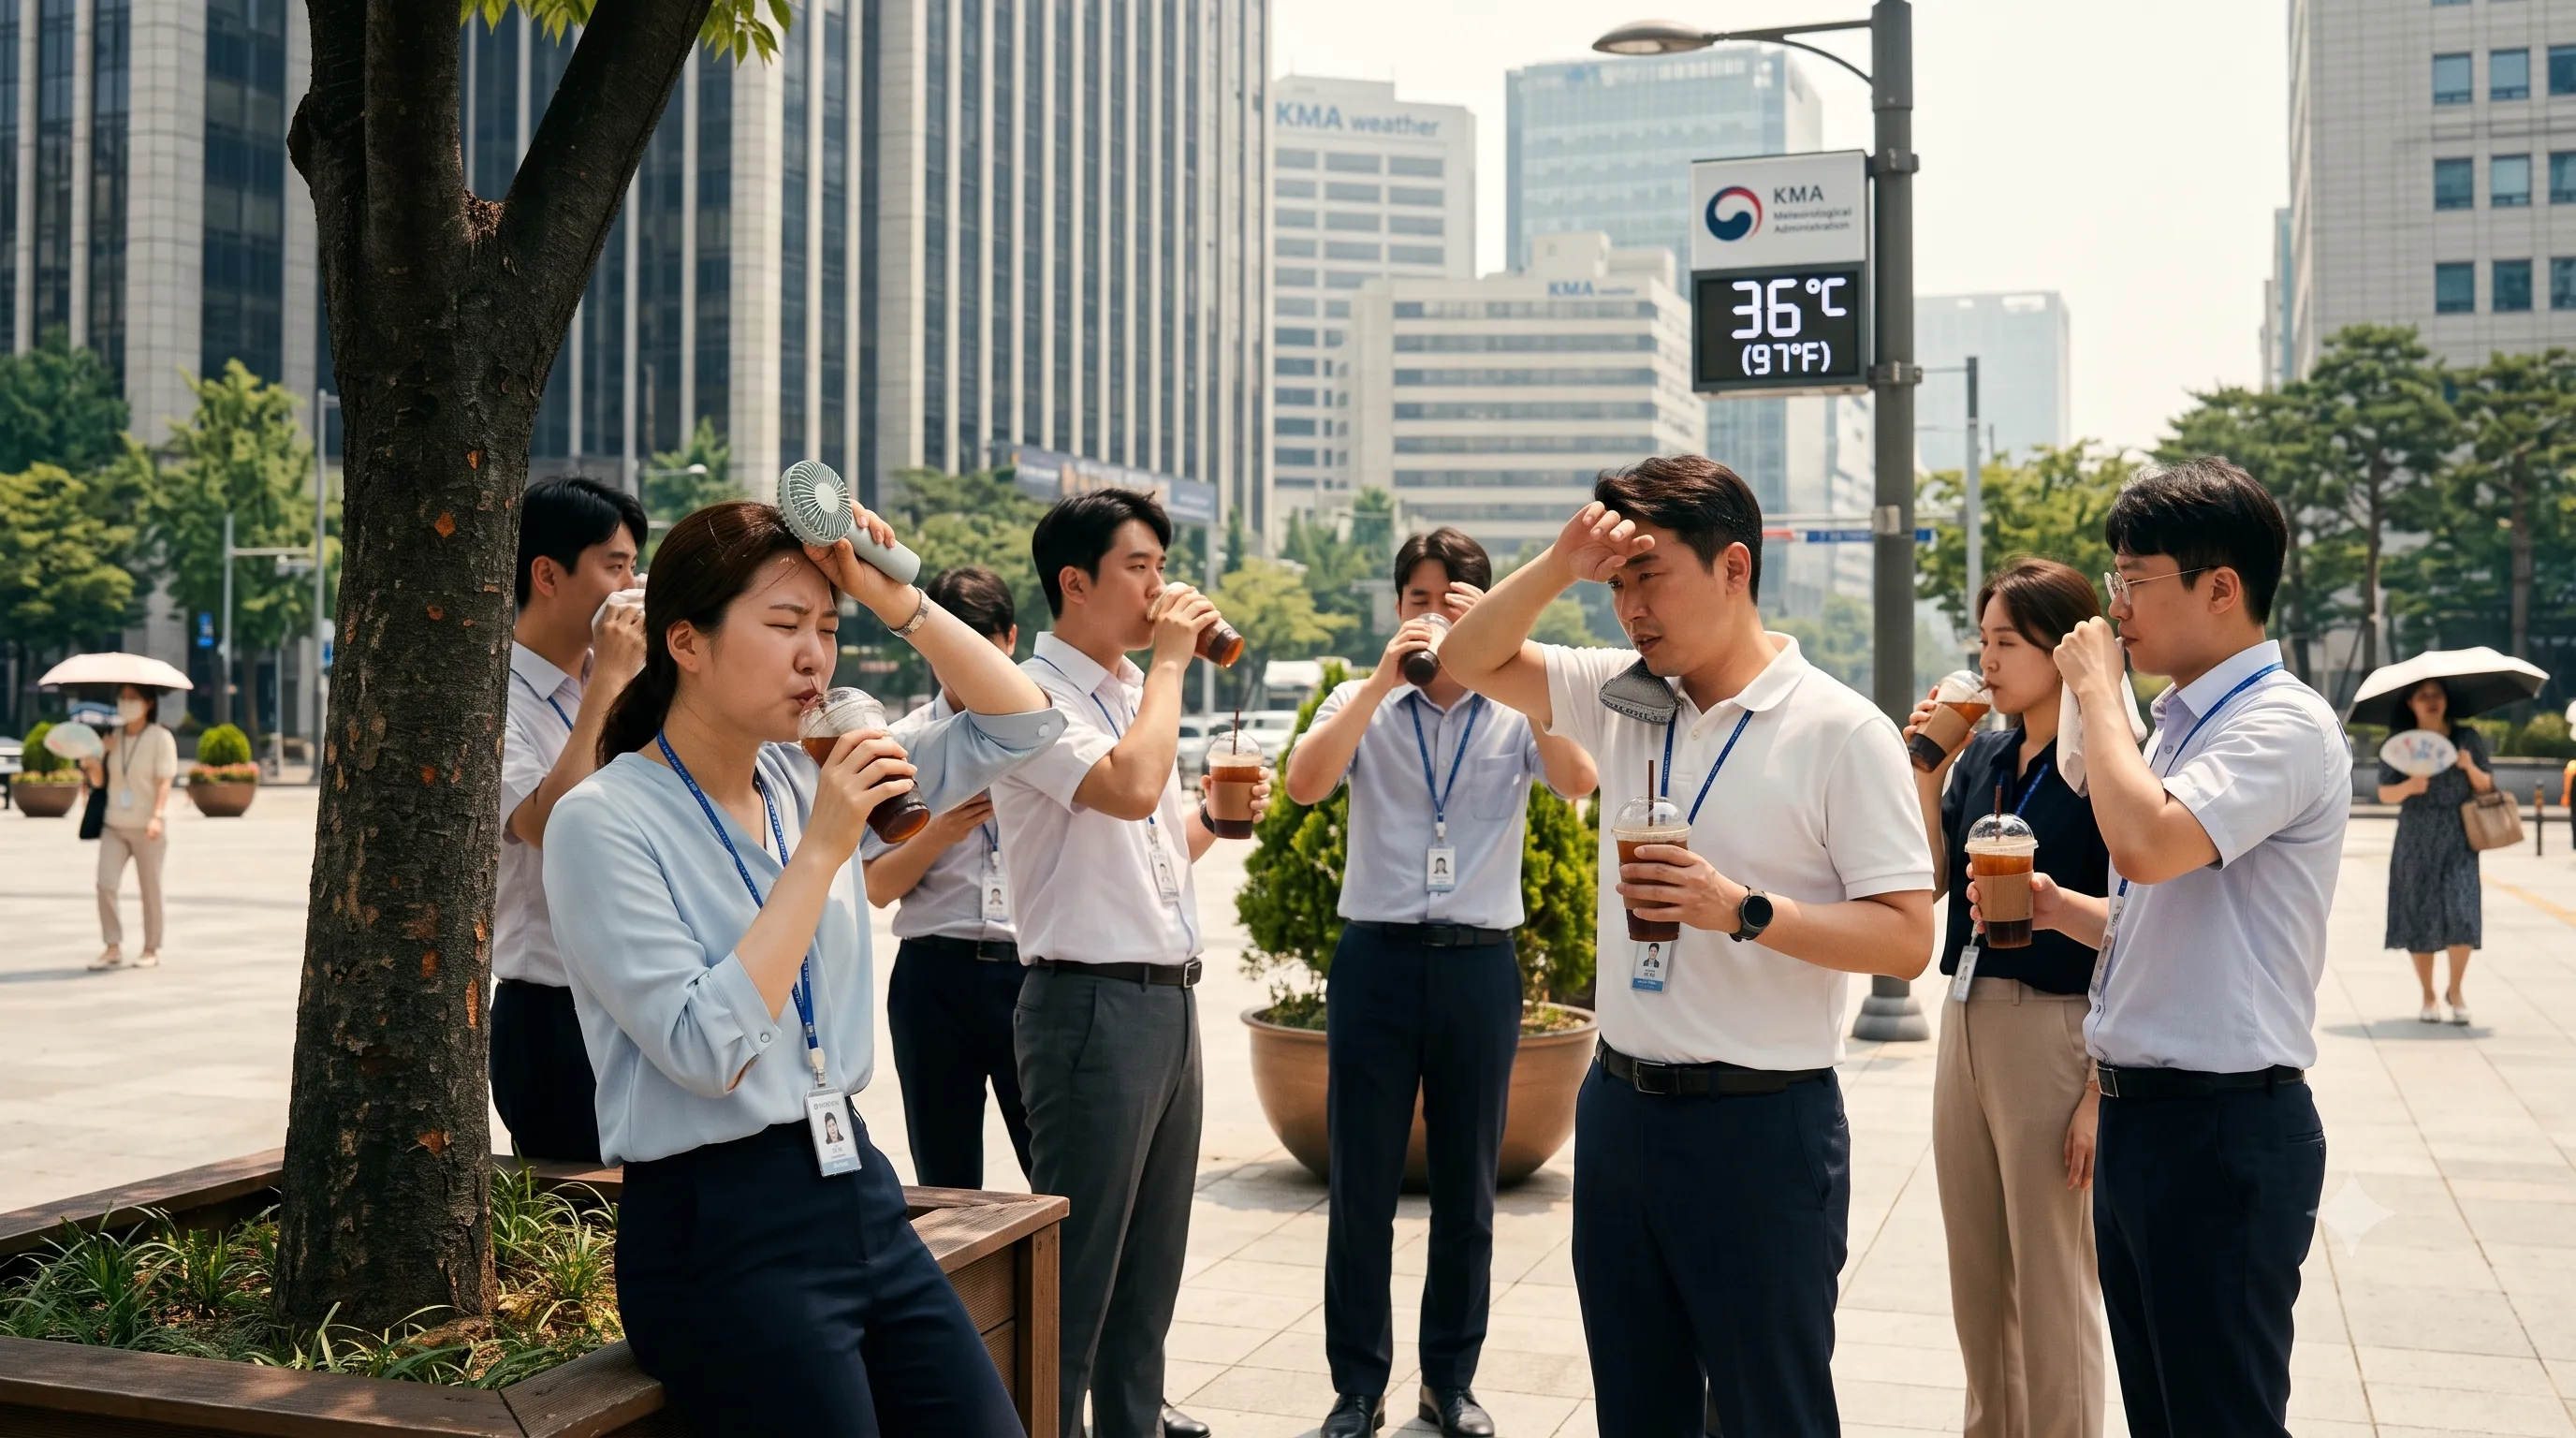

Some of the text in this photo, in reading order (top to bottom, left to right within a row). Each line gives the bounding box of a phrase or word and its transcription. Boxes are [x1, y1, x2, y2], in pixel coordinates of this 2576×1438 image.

[1275, 101, 1440, 137] KMA weather
[1774, 184, 1824, 204] KMA
[1548, 279, 1595, 296] KMA
[1741, 340, 1831, 376] (97°F)
